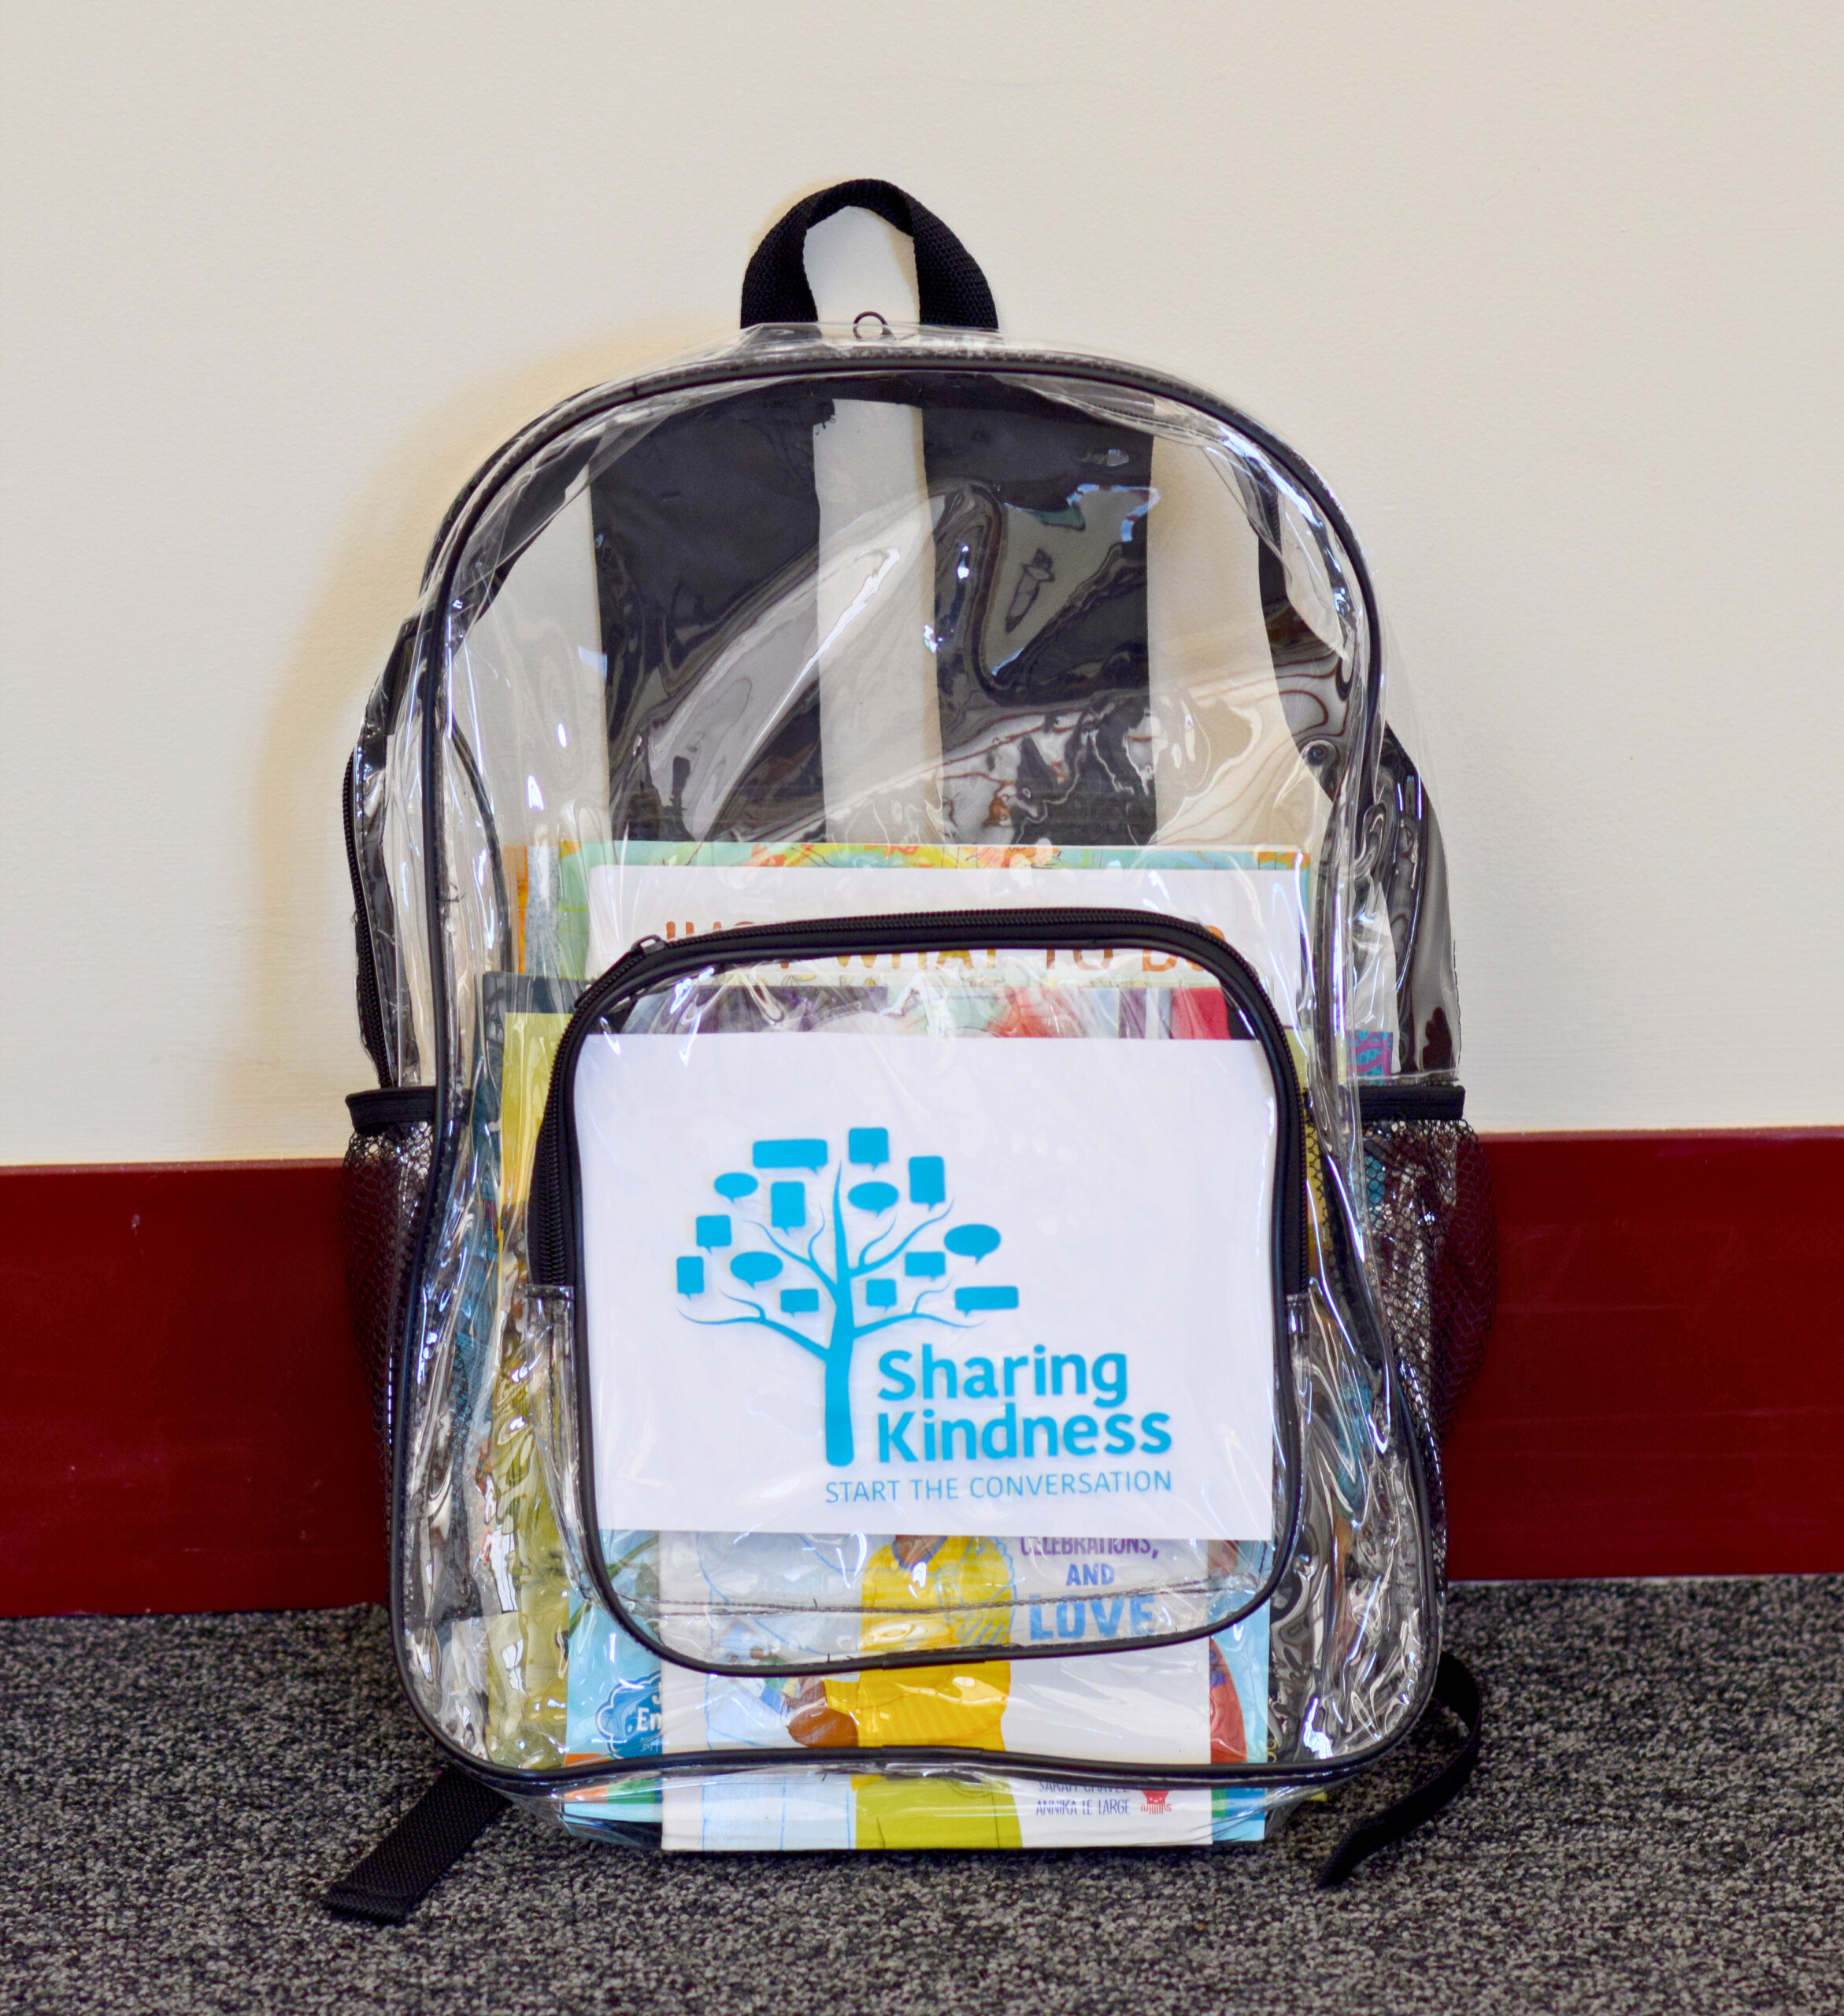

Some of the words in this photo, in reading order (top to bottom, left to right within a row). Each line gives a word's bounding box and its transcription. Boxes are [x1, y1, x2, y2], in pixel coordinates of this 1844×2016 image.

[877, 1343, 1128, 1408] Sharing
[877, 1402, 1172, 1464] Kindness
[825, 1480, 901, 1504] START
[909, 1477, 959, 1500] THE
[969, 1469, 1172, 1499] CONVERSATION
[1065, 1562, 1116, 1587] AND
[1028, 1593, 1156, 1641] LOVE
[1035, 1799, 1078, 1816] ANNIKA
[1082, 1799, 1093, 1815] LE
[1098, 1798, 1131, 1815] LARGE
